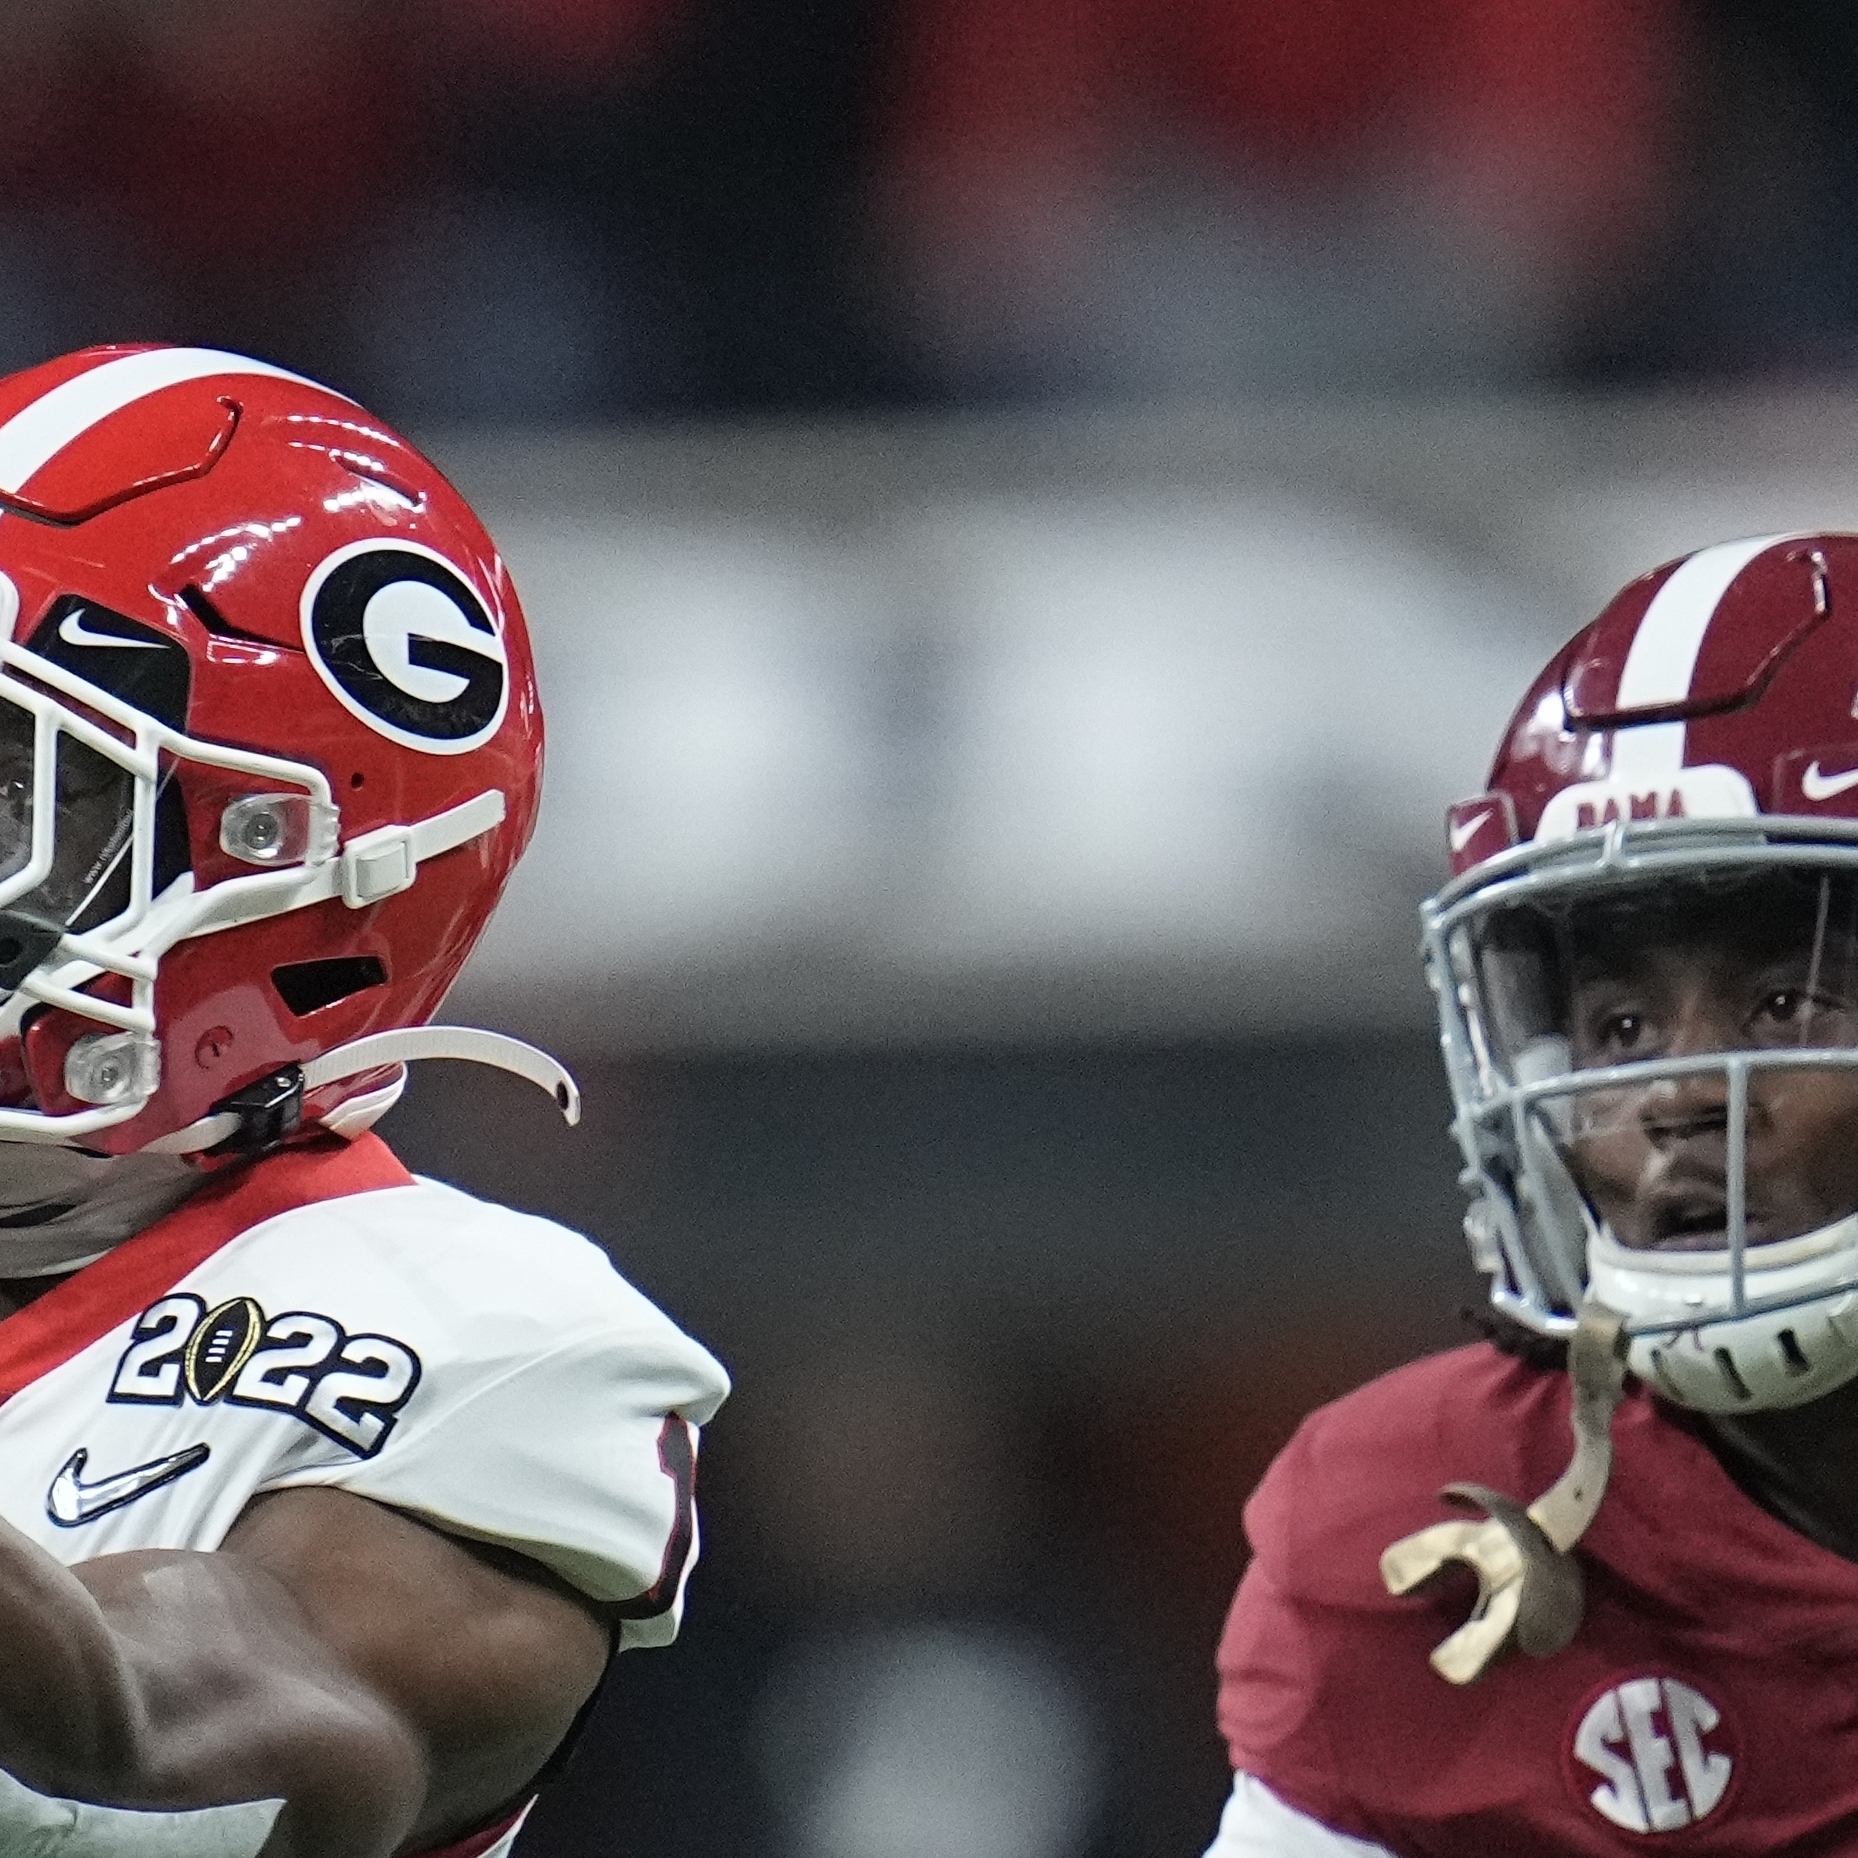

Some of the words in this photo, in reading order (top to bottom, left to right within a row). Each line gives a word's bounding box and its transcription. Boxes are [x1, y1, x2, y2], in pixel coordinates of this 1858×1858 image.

[304, 541, 507, 748] G
[107, 1293, 422, 1459] 2022
[1574, 1677, 1732, 1833] SEC
